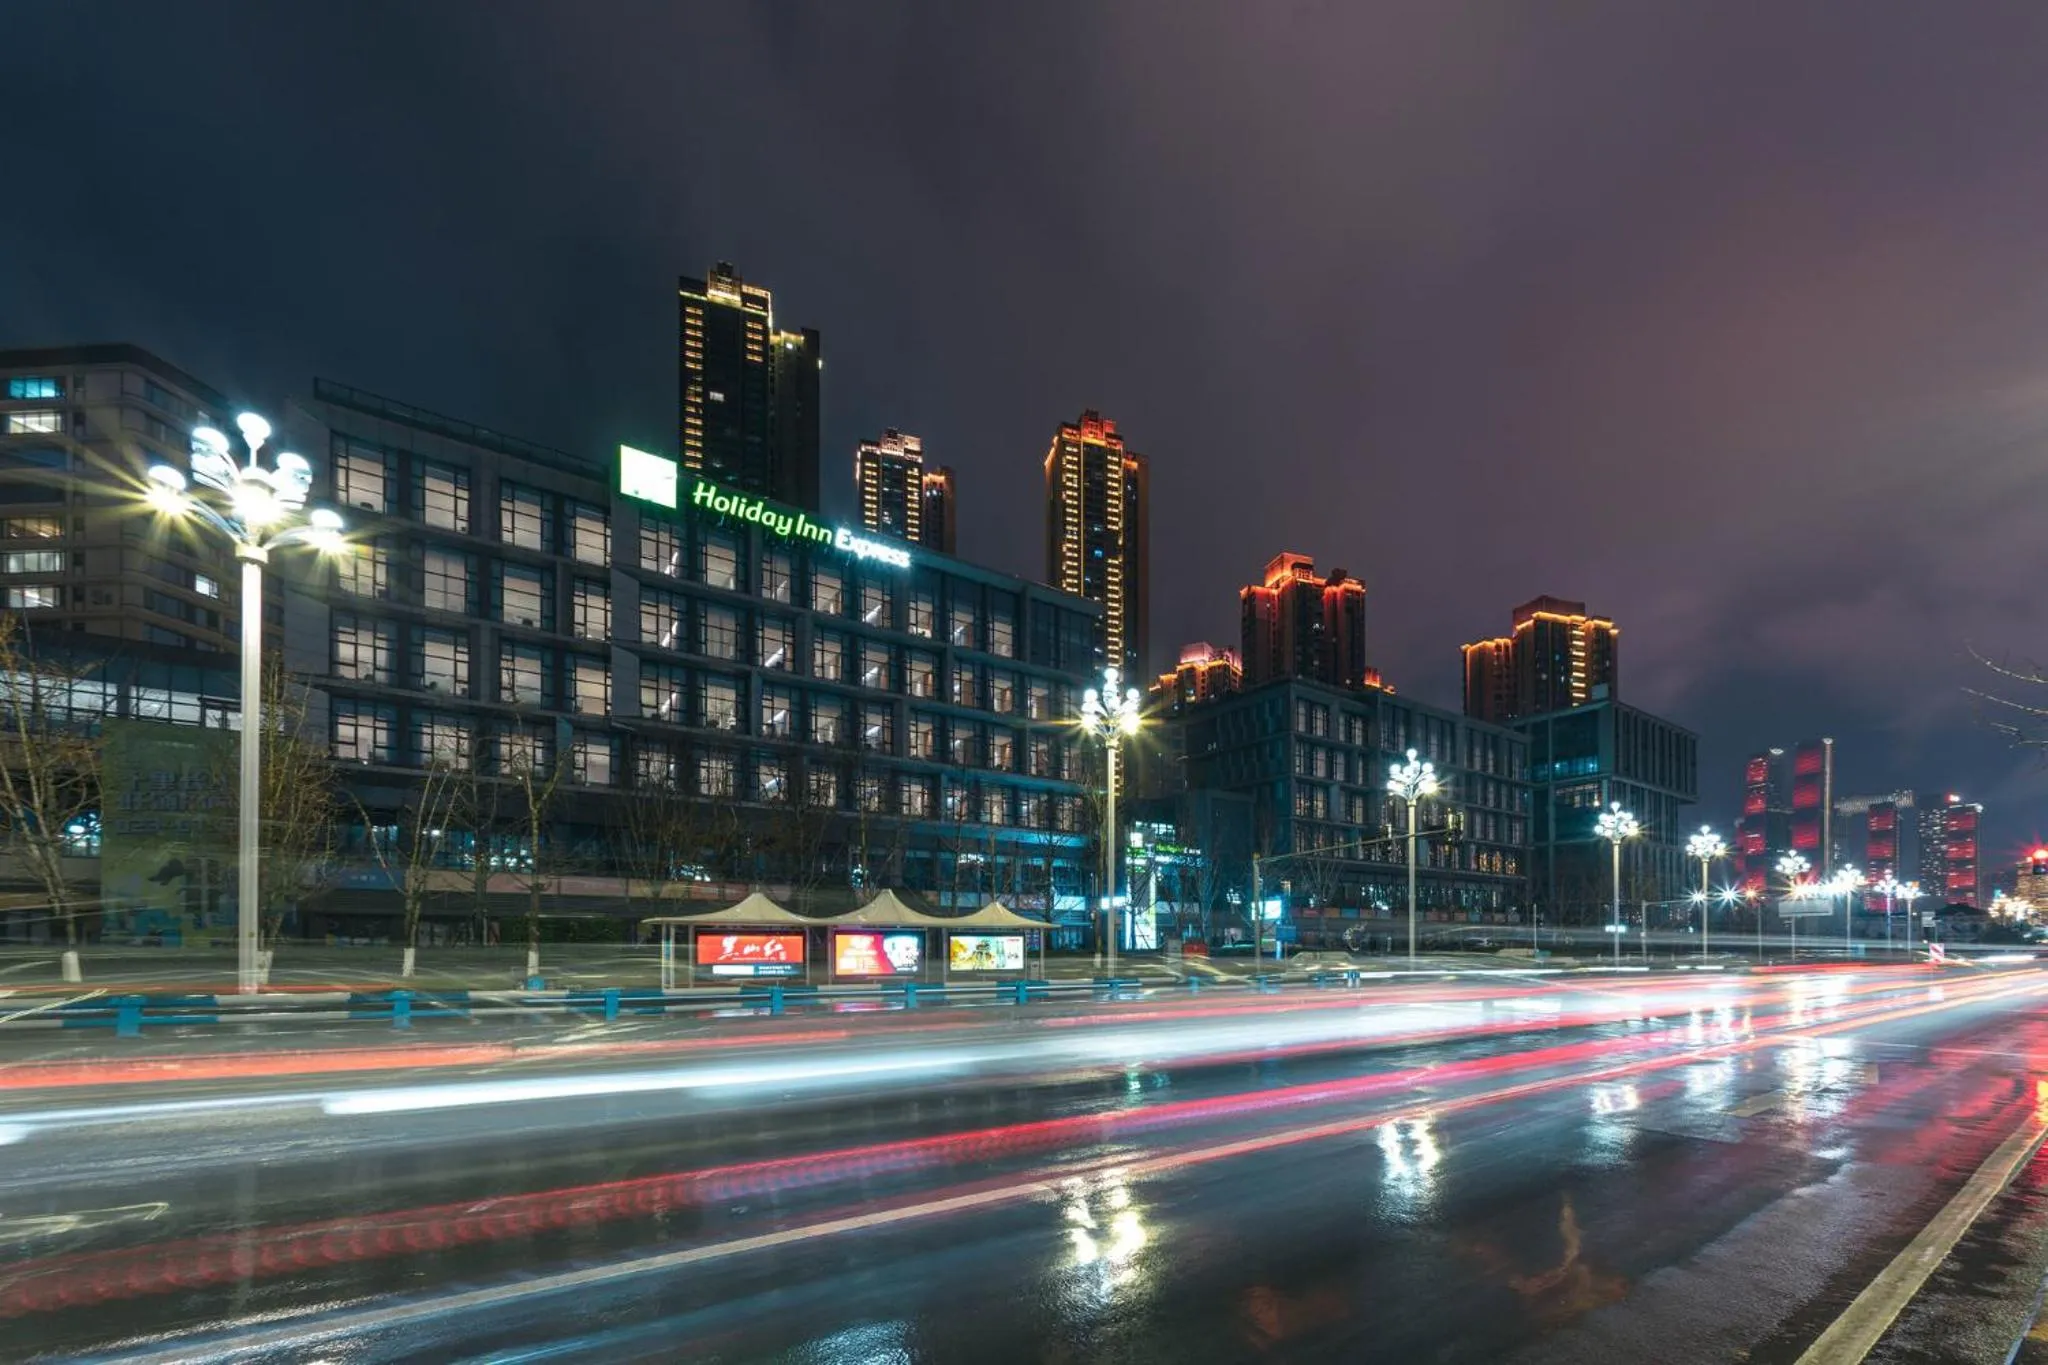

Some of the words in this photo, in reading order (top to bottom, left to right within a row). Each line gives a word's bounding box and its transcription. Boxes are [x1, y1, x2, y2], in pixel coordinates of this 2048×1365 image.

[692, 481, 793, 537] Holiday
[796, 514, 832, 545] Inn
[835, 527, 911, 568] Express
